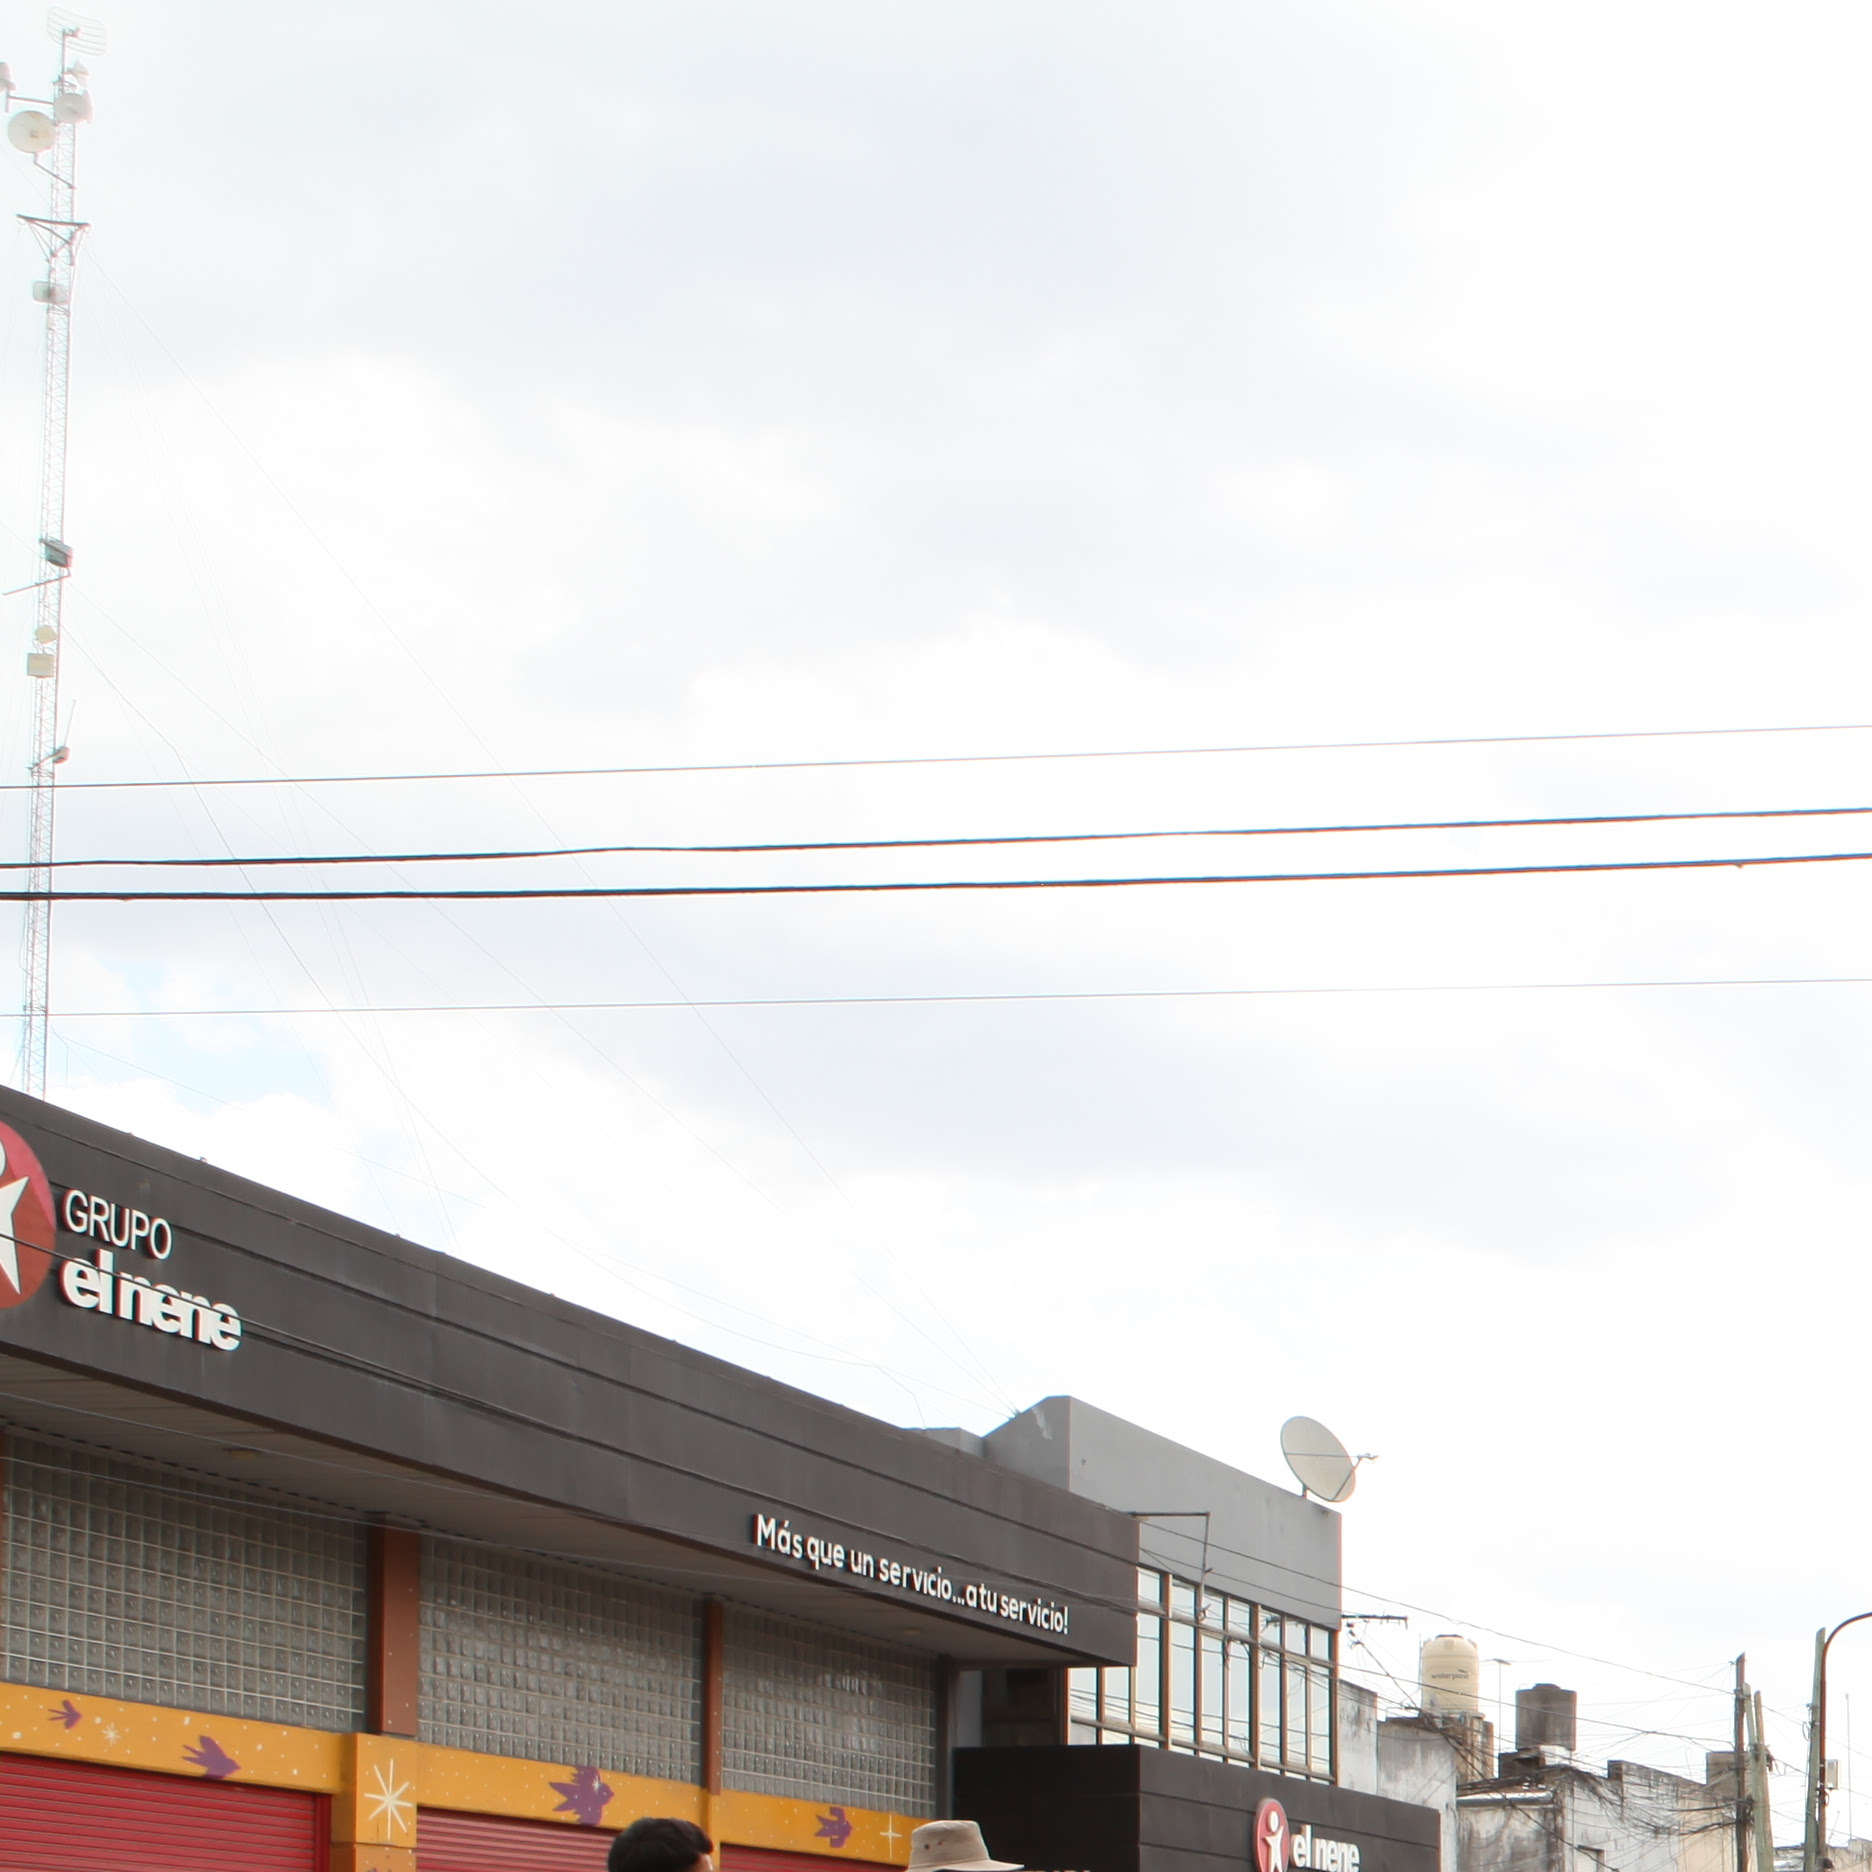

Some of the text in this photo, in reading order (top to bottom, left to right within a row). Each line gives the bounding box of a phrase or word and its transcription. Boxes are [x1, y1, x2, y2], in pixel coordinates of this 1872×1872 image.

[65, 1189, 173, 1260] GRUPO
[755, 1513, 803, 1558] Más
[806, 1536, 845, 1570] que
[850, 1549, 875, 1578] un
[1000, 1598, 1069, 1635] servicio!
[1292, 1825, 1313, 1868] el
